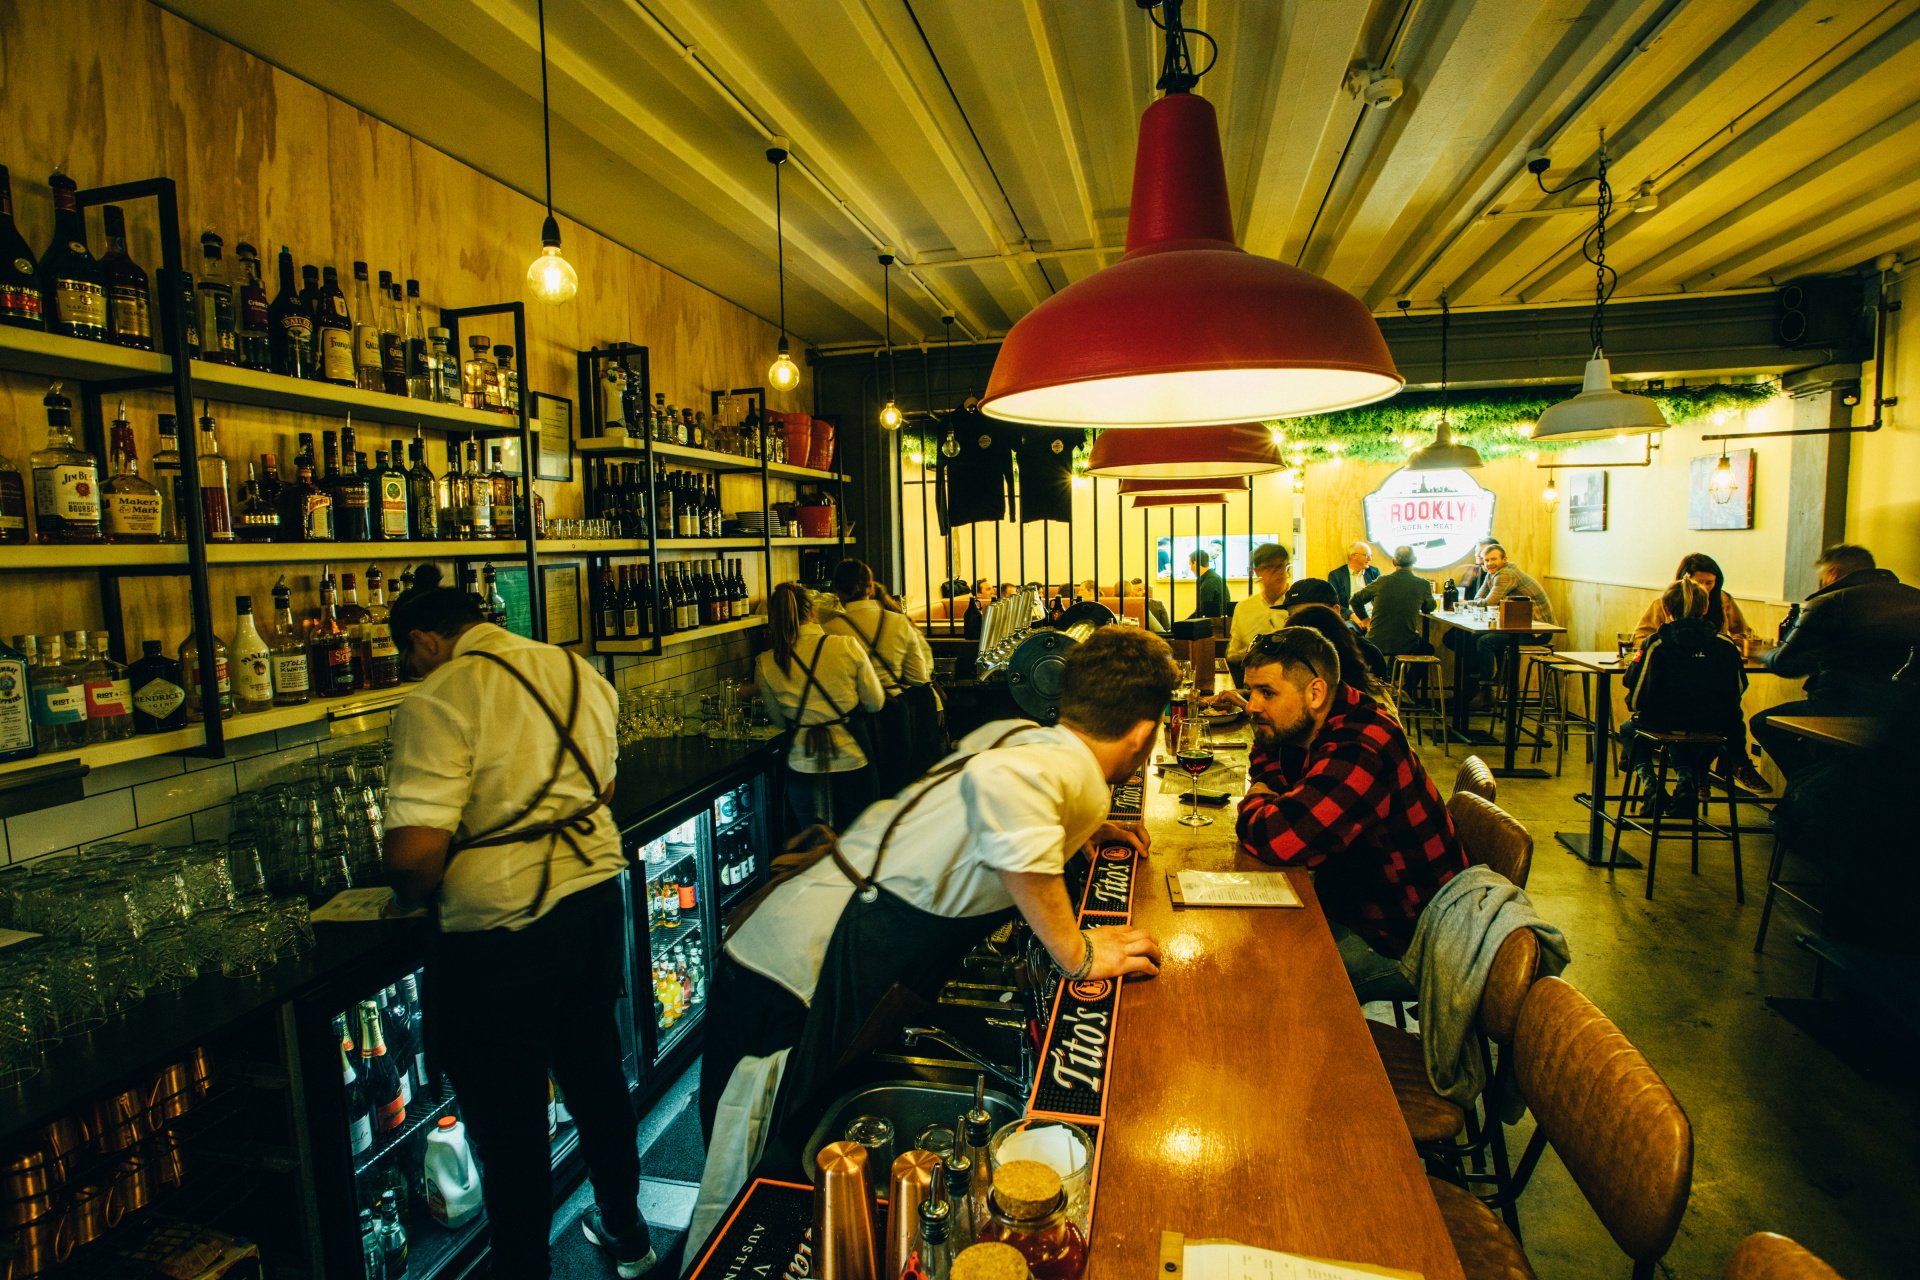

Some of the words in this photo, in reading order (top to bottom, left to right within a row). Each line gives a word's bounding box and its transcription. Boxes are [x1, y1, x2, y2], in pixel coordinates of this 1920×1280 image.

[119, 497, 159, 505] Maker's
[132, 506, 159, 514] Mark
[1389, 500, 1477, 522] ROOKLY
[1094, 861, 1131, 902] Tito's
[1050, 1006, 1109, 1093] Tito's
